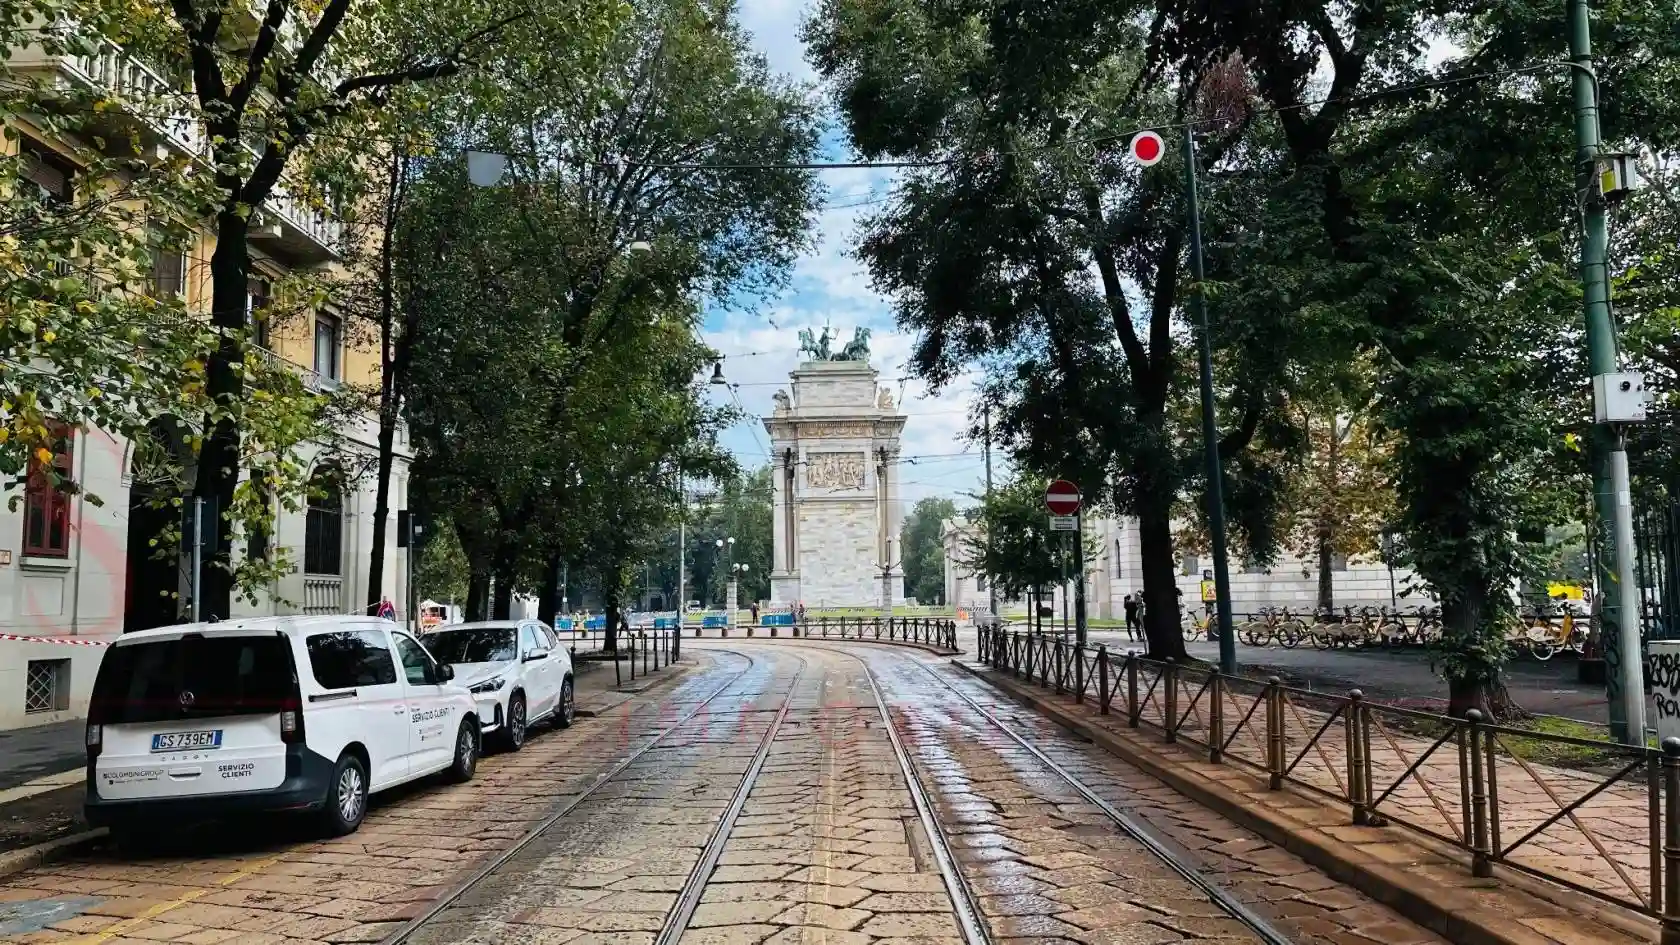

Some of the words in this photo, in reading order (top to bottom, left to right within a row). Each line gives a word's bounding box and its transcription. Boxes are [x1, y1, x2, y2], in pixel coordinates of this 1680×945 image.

[160, 735, 175, 747] GS
[177, 732, 213, 746] 739EM
[218, 763, 255, 772] SERVIZIO
[221, 770, 252, 779] CLIENTI
